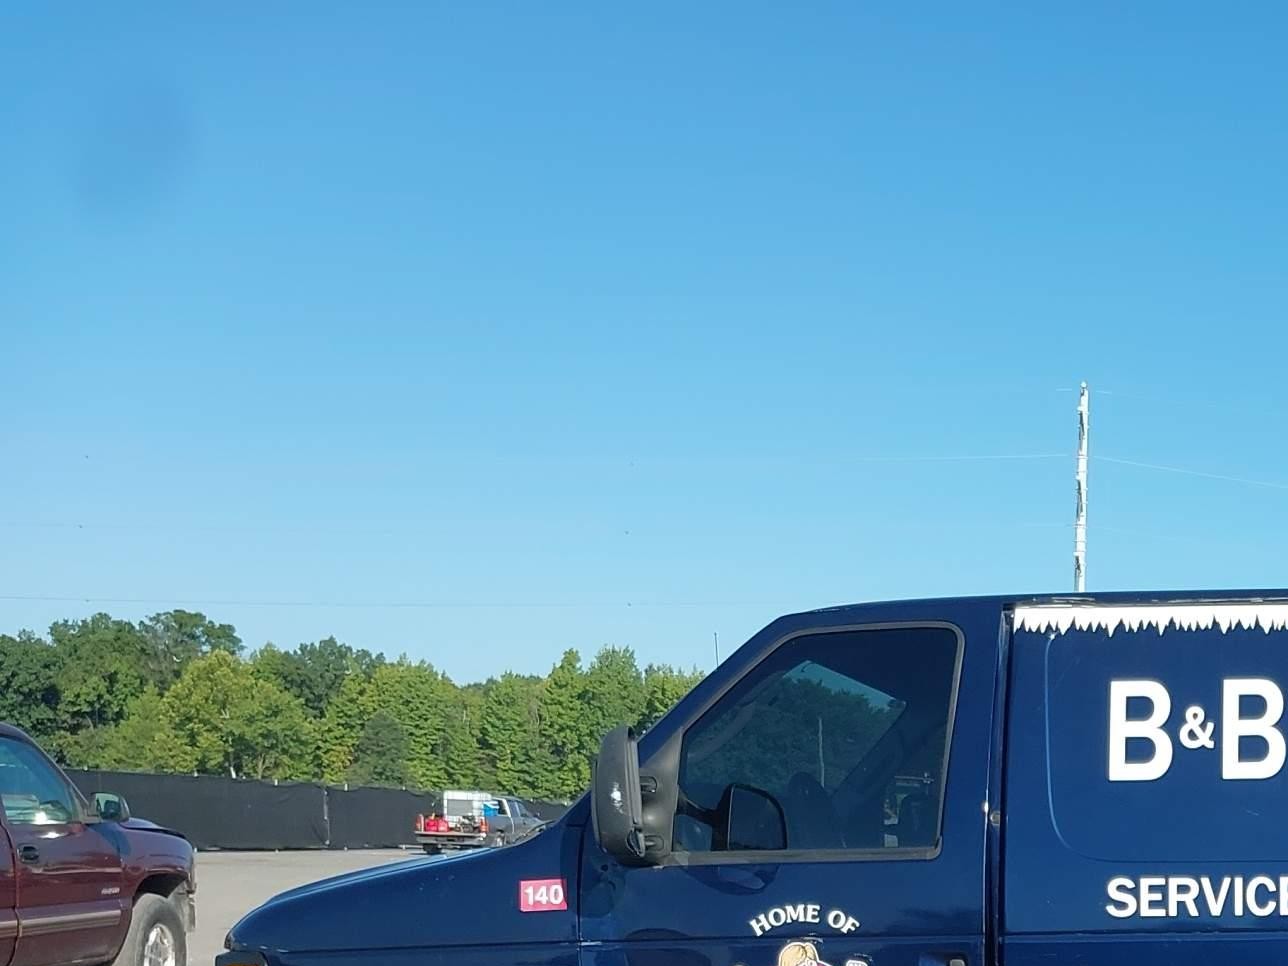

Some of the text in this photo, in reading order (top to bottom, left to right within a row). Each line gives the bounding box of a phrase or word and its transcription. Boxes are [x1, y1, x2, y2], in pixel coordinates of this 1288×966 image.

[524, 884, 563, 906] 140
[749, 904, 861, 936] HOME OF
